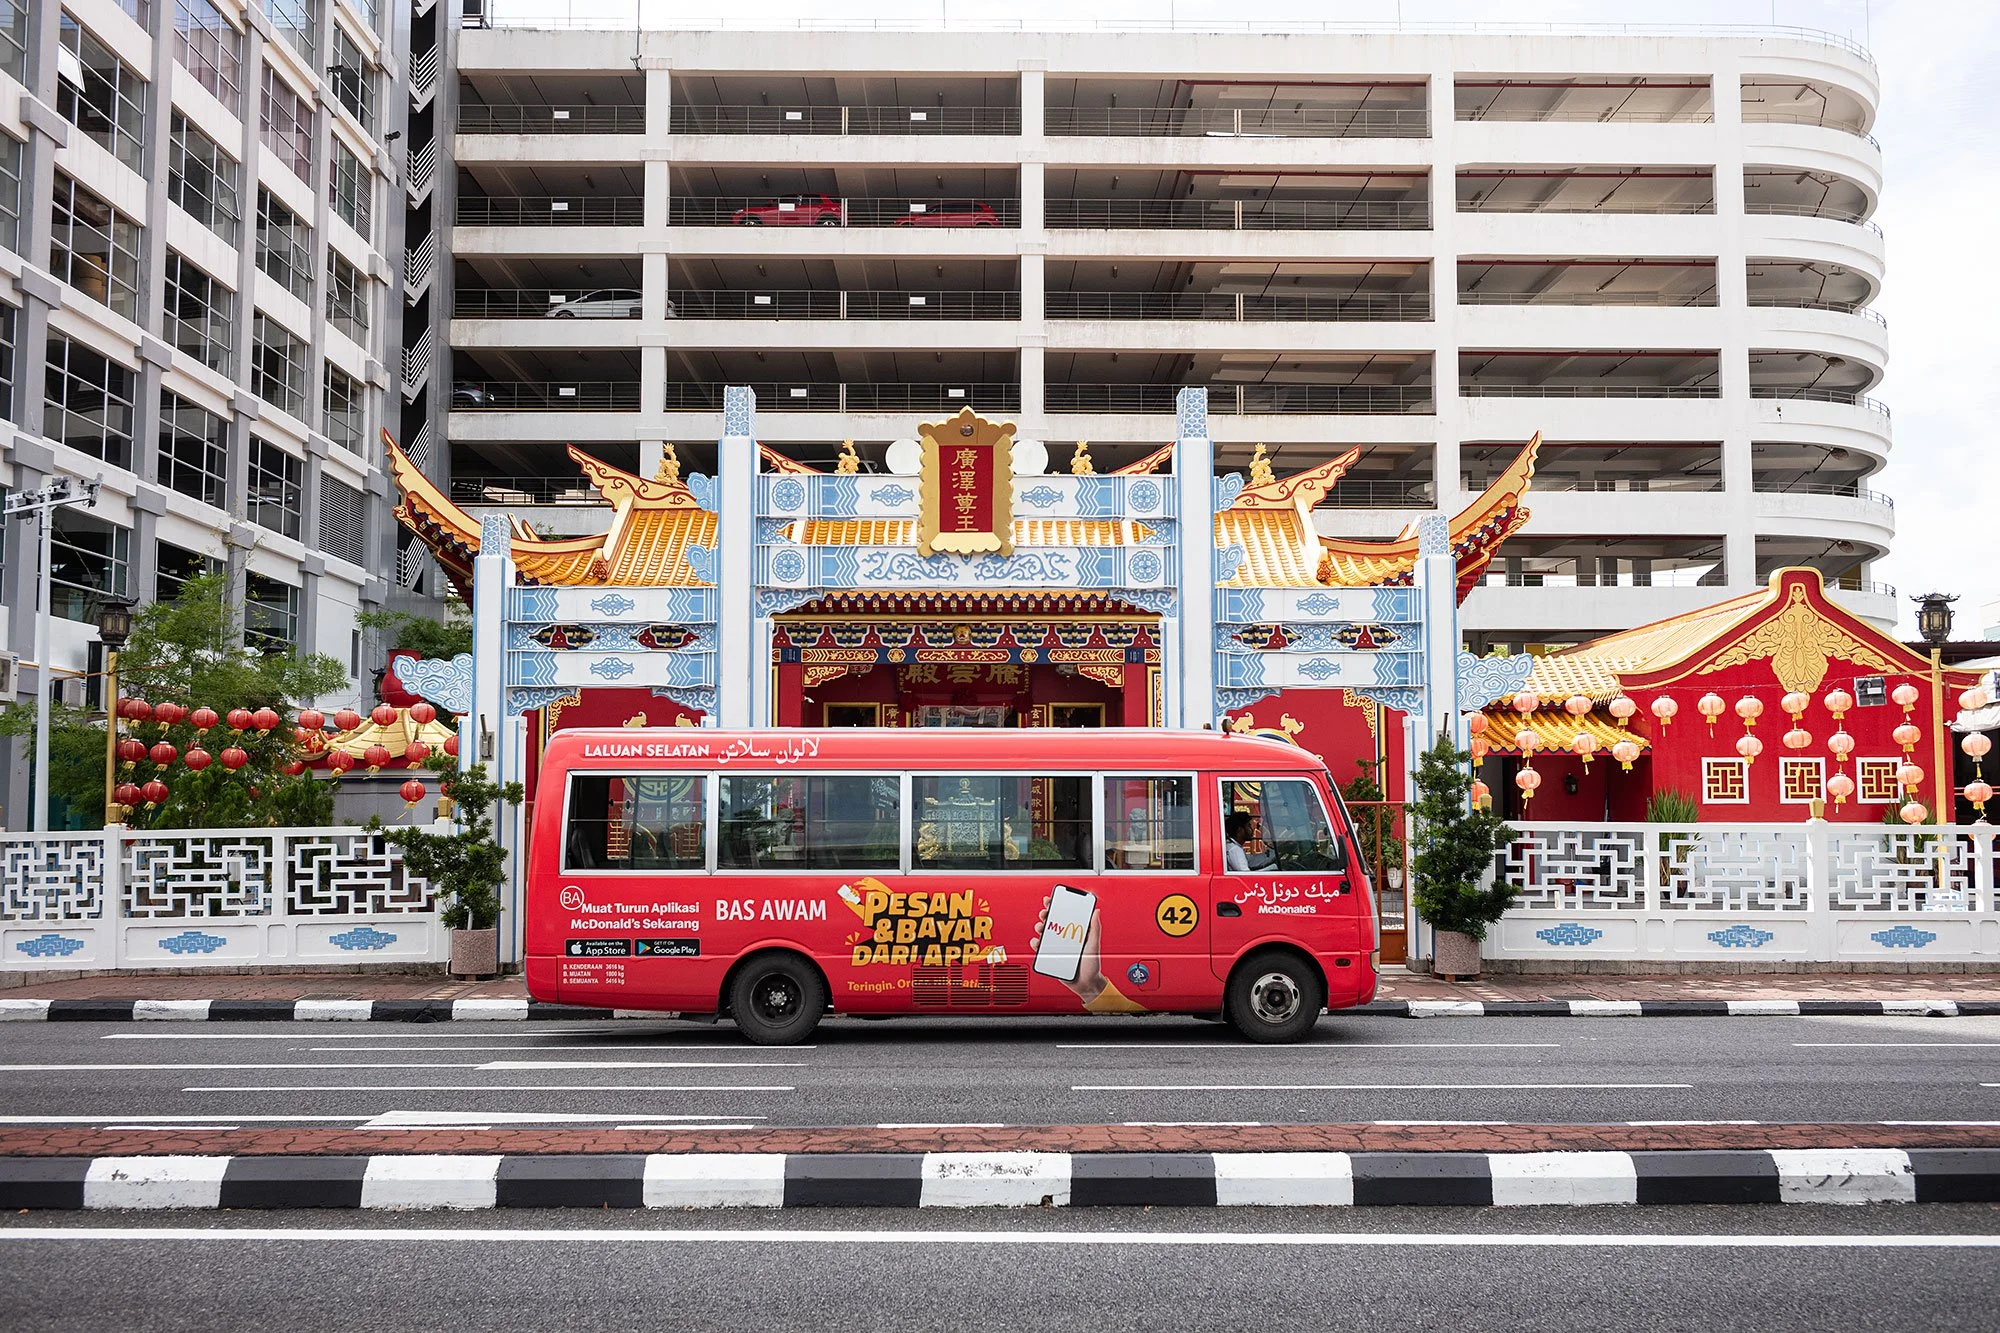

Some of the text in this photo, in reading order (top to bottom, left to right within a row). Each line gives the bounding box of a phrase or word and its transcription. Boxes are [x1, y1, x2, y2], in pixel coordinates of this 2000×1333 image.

[951, 447, 979, 533] 廣澤尊王
[585, 744, 710, 757] LALUAN SELATAN
[717, 737, 771, 764] سلاتن
[563, 891, 581, 904] BA
[581, 902, 700, 916] Muat Turun Aplikasi
[716, 899, 827, 921] BAS AWAM
[864, 889, 974, 926] PESAN
[1258, 905, 1316, 914] McDonald's
[1162, 906, 1193, 925] 42
[571, 918, 700, 932] McDonald's Sekarang
[586, 947, 626, 956] App Store
[654, 946, 697, 955] Google Play
[852, 943, 980, 966] DARI APP
[847, 980, 895, 993] Teringin.
